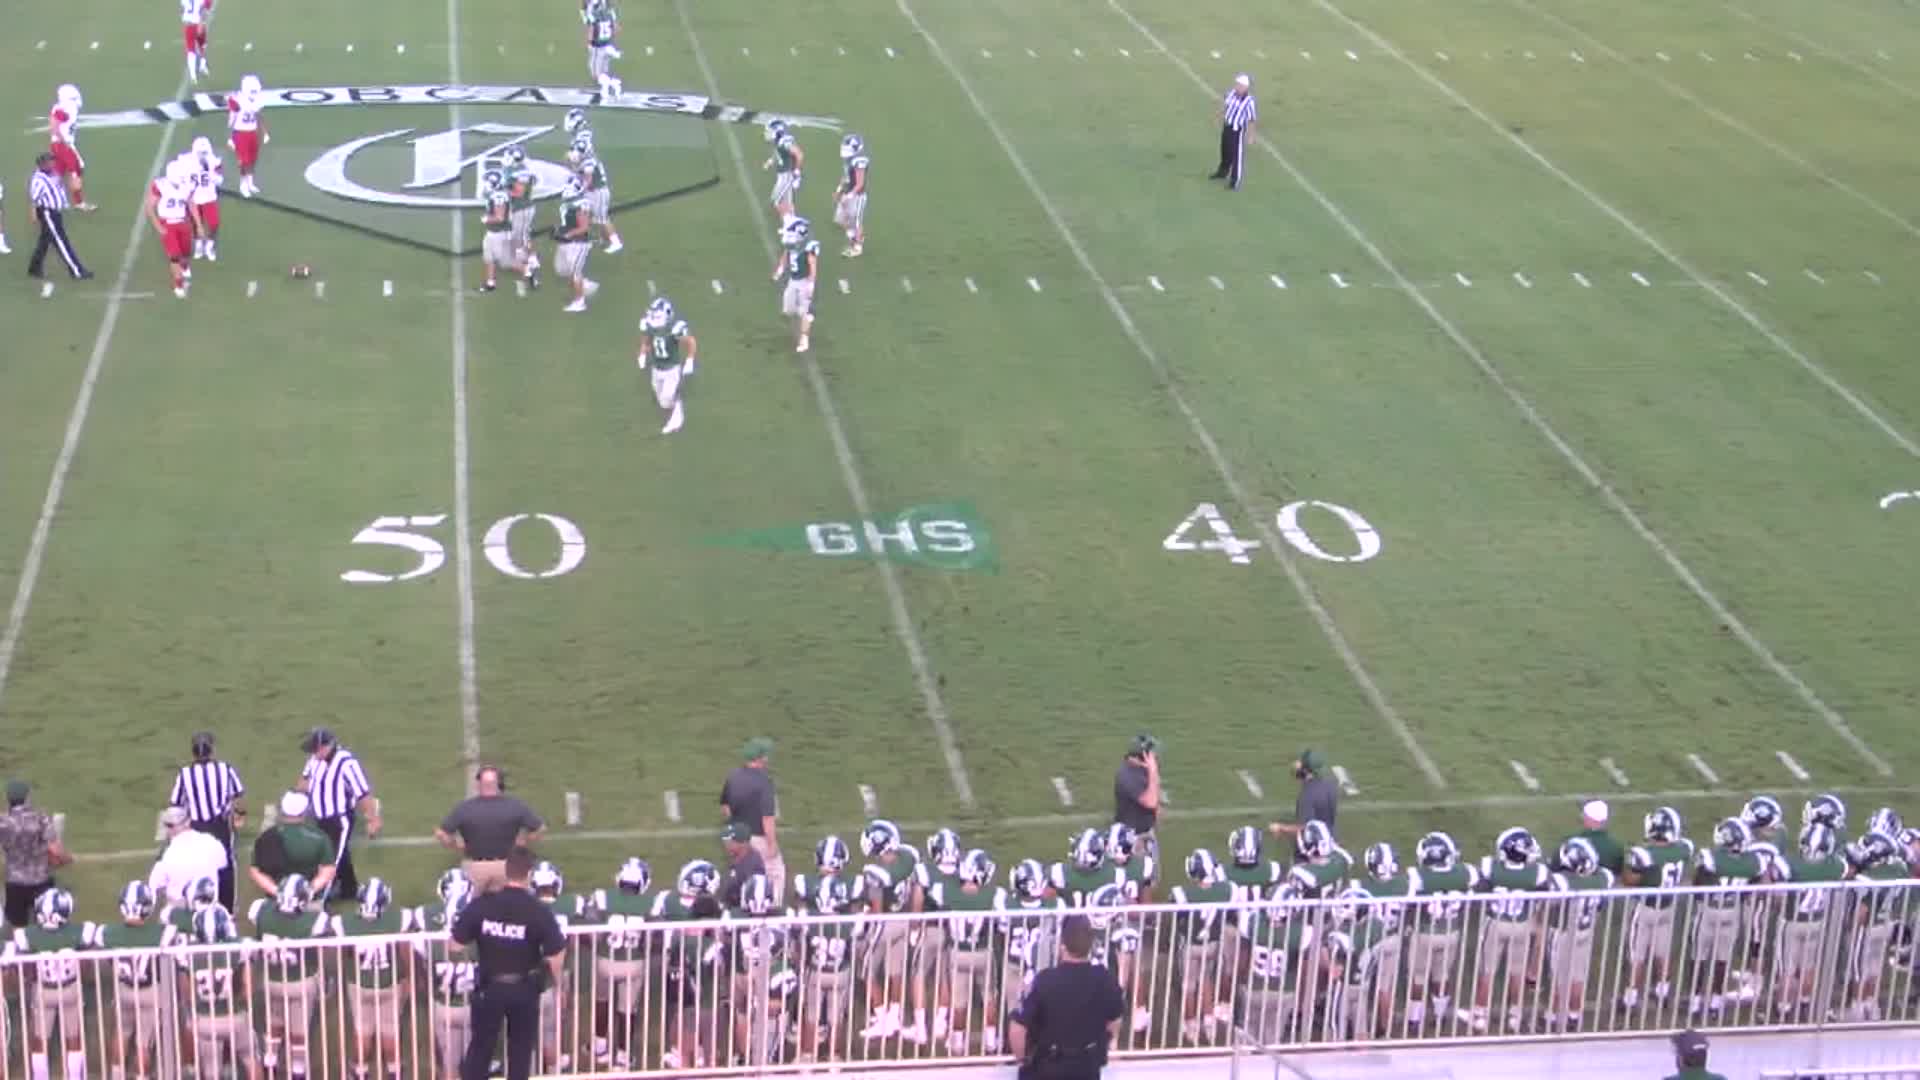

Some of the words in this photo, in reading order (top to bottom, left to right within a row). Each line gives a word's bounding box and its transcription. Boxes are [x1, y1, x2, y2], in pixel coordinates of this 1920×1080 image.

[220, 86, 688, 108] OBCATS
[340, 512, 587, 583] 50
[806, 519, 976, 556] GHS
[1163, 500, 1382, 565] 40
[481, 919, 527, 940] POLICE
